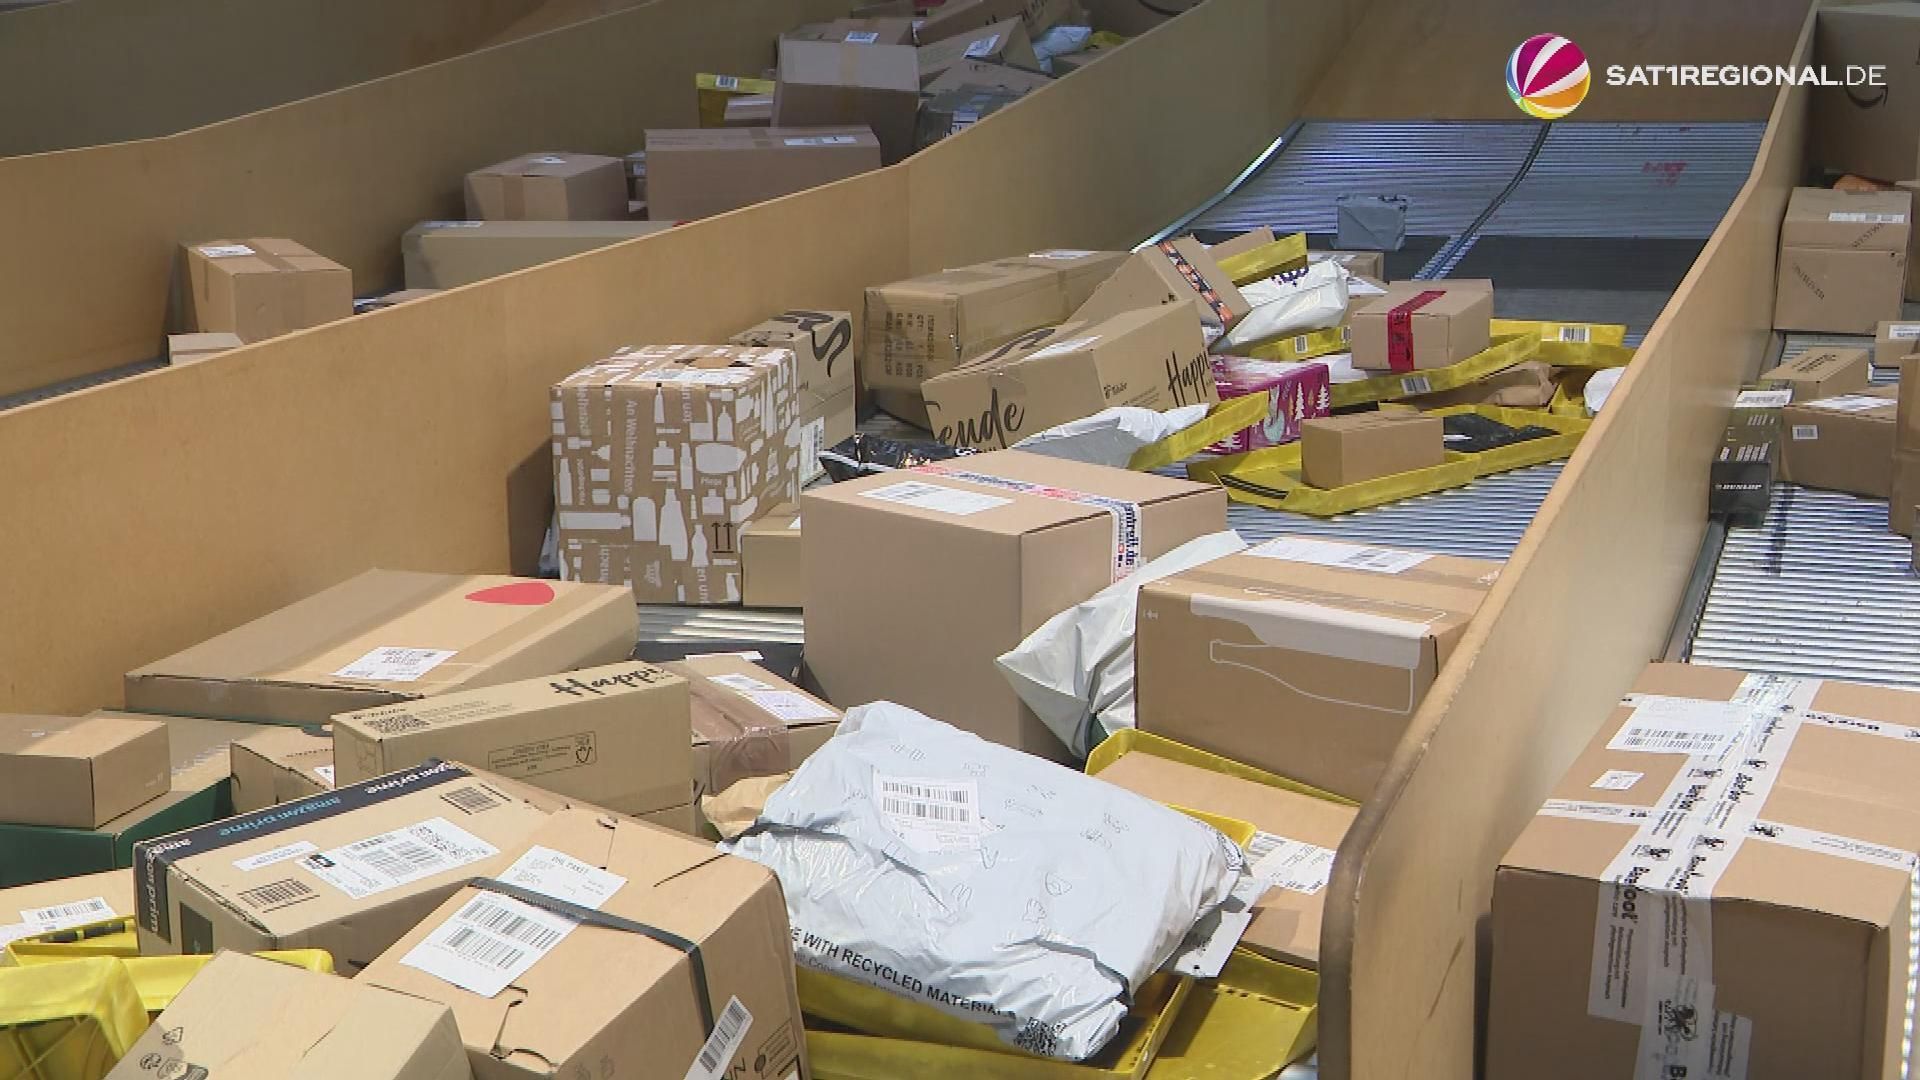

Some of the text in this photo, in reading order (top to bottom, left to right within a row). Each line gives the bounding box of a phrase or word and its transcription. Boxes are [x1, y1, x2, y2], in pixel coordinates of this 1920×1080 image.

[802, 931, 840, 959] WITH
[841, 947, 922, 995] RECYCLED
[926, 985, 1017, 1019] MATERIA
